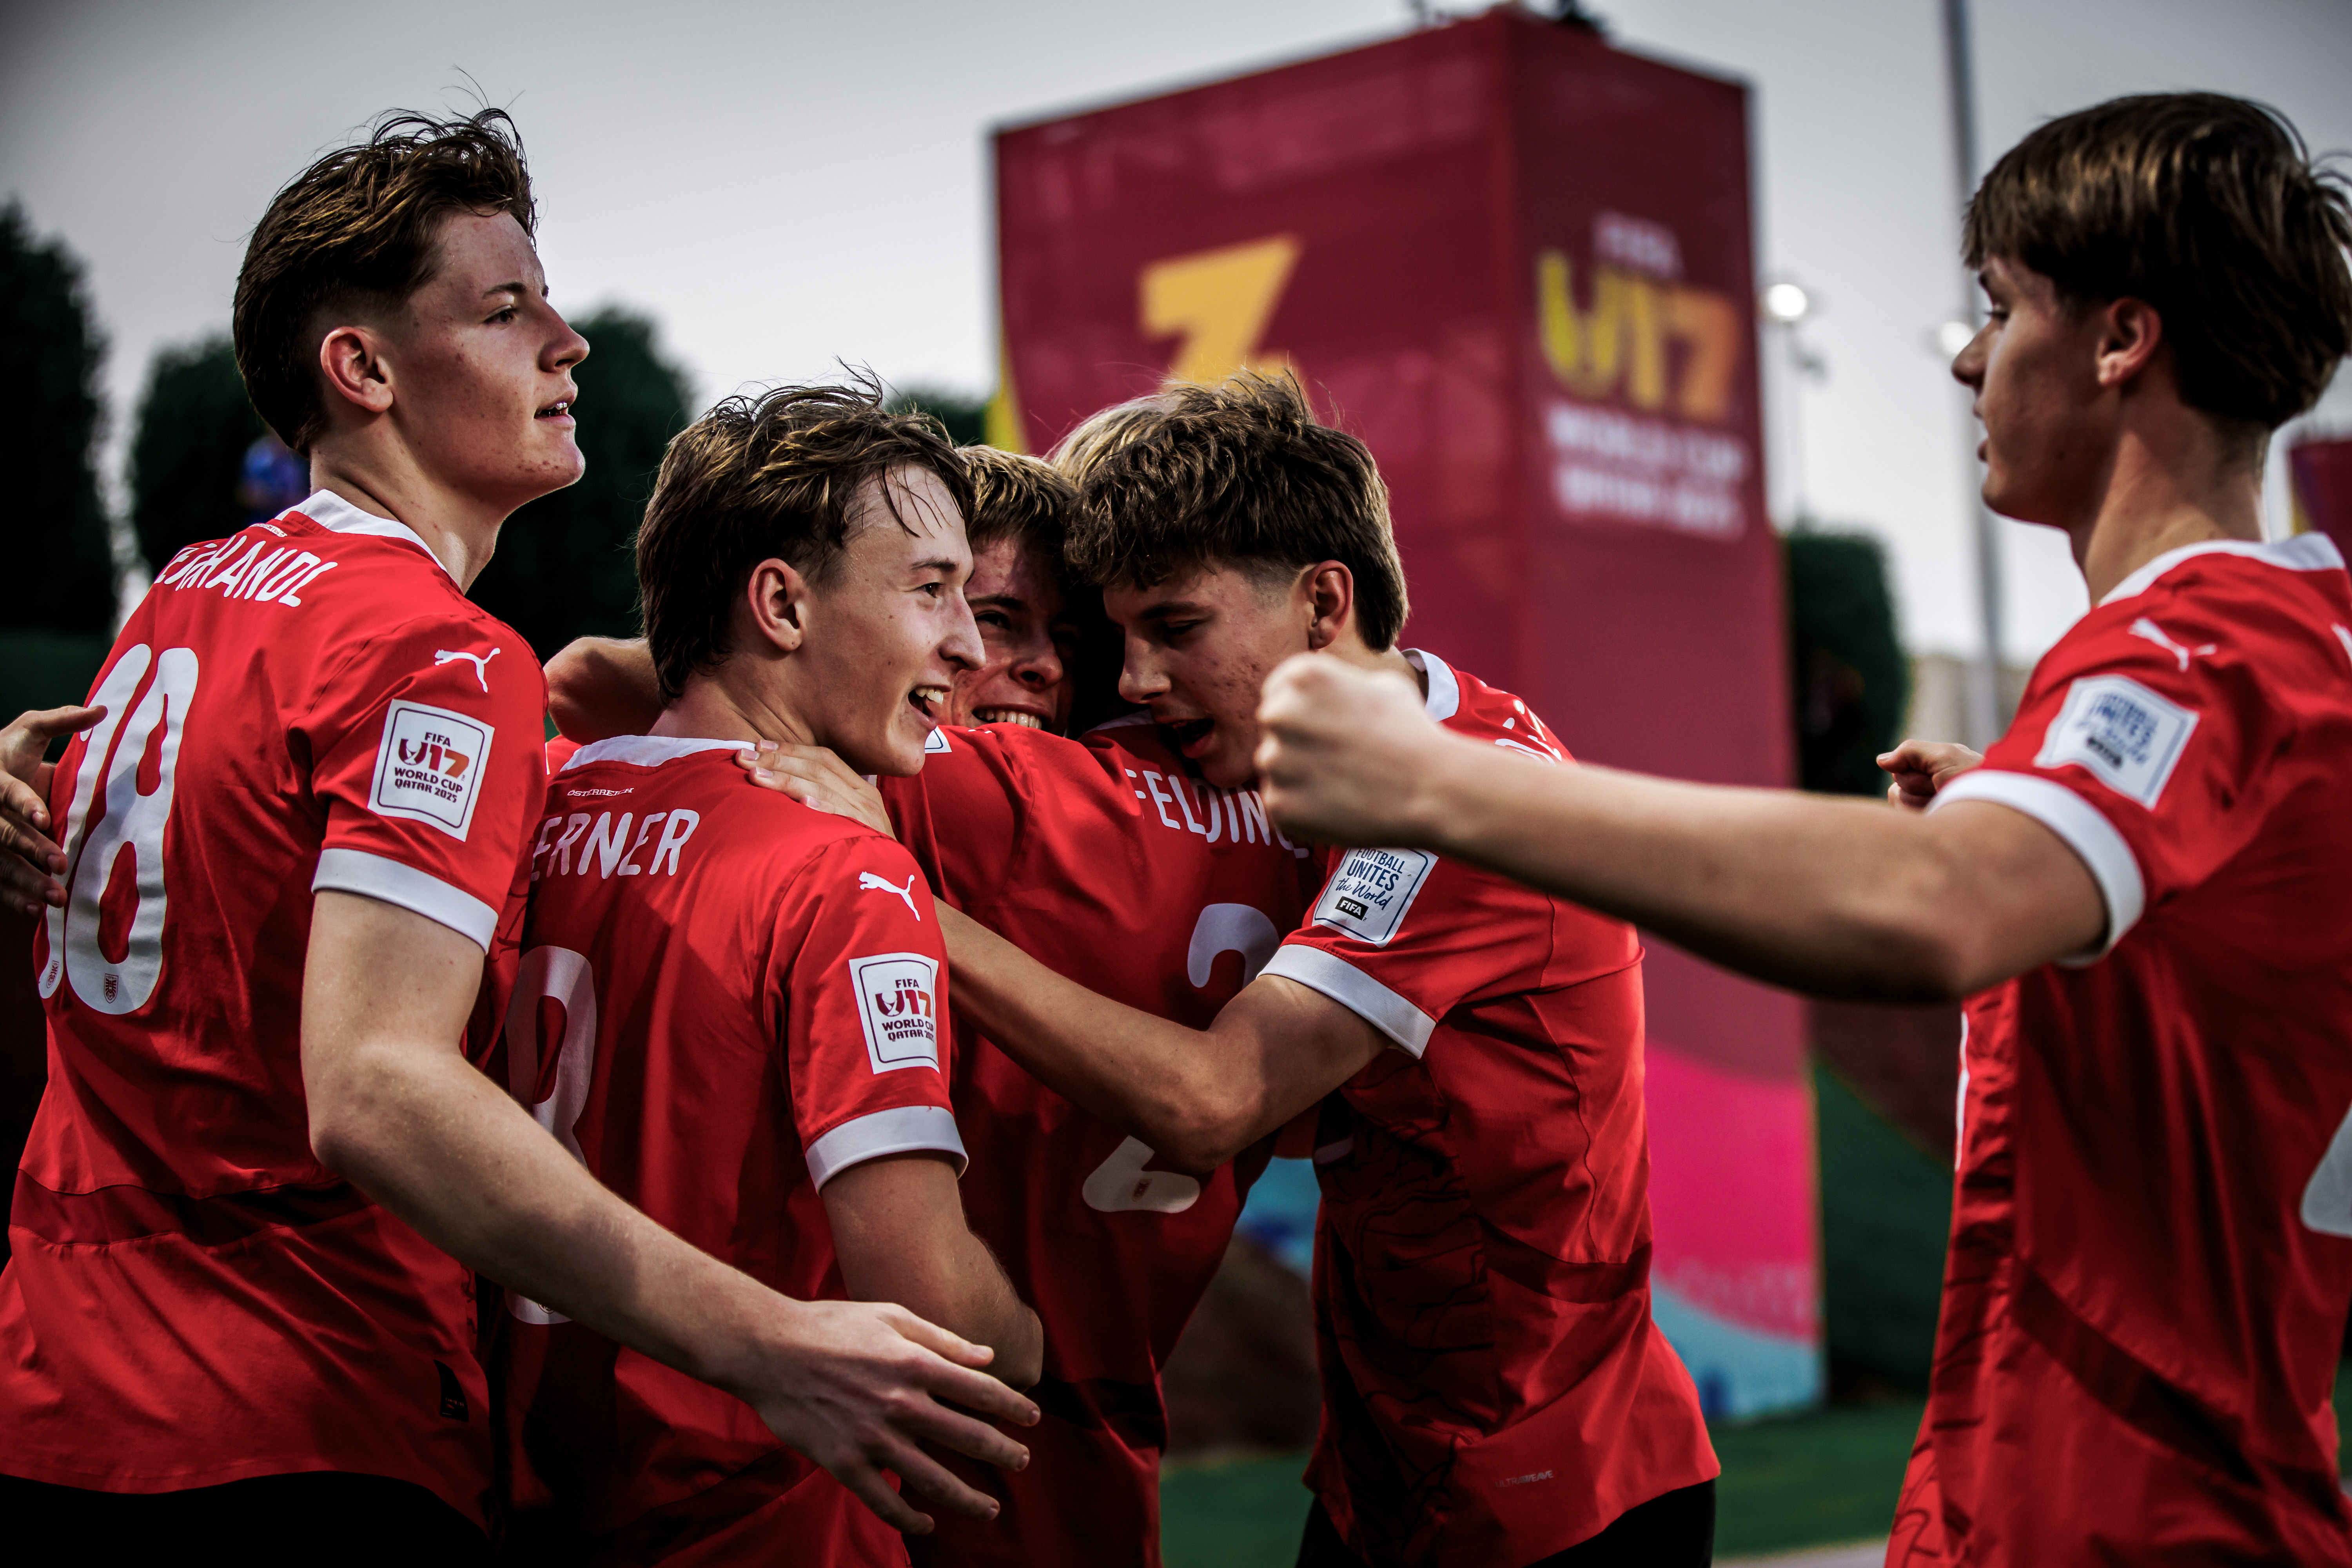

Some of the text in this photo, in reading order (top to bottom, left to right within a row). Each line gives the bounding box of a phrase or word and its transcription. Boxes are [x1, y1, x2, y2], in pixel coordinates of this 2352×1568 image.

[1537, 250, 1740, 421] U17
[425, 732, 451, 747] FIFA
[398, 738, 470, 779] U17
[394, 767, 463, 793] WORLD CUP
[395, 778, 457, 803] QATAR 2025
[567, 788, 634, 797] ÖSTERREICH
[531, 808, 700, 882] ERNER
[1355, 848, 1405, 874] FOOTBALL
[1347, 859, 1399, 891] UNITES
[1335, 878, 1394, 911] the World
[1340, 900, 1362, 916] FIFA
[895, 978, 920, 989] FIFA
[875, 989, 931, 1018] U17
[882, 1018, 924, 1031] WORLD
[887, 1029, 924, 1042] QATAR
[1495, 1470, 1554, 1488] ULTRAWEAVE
